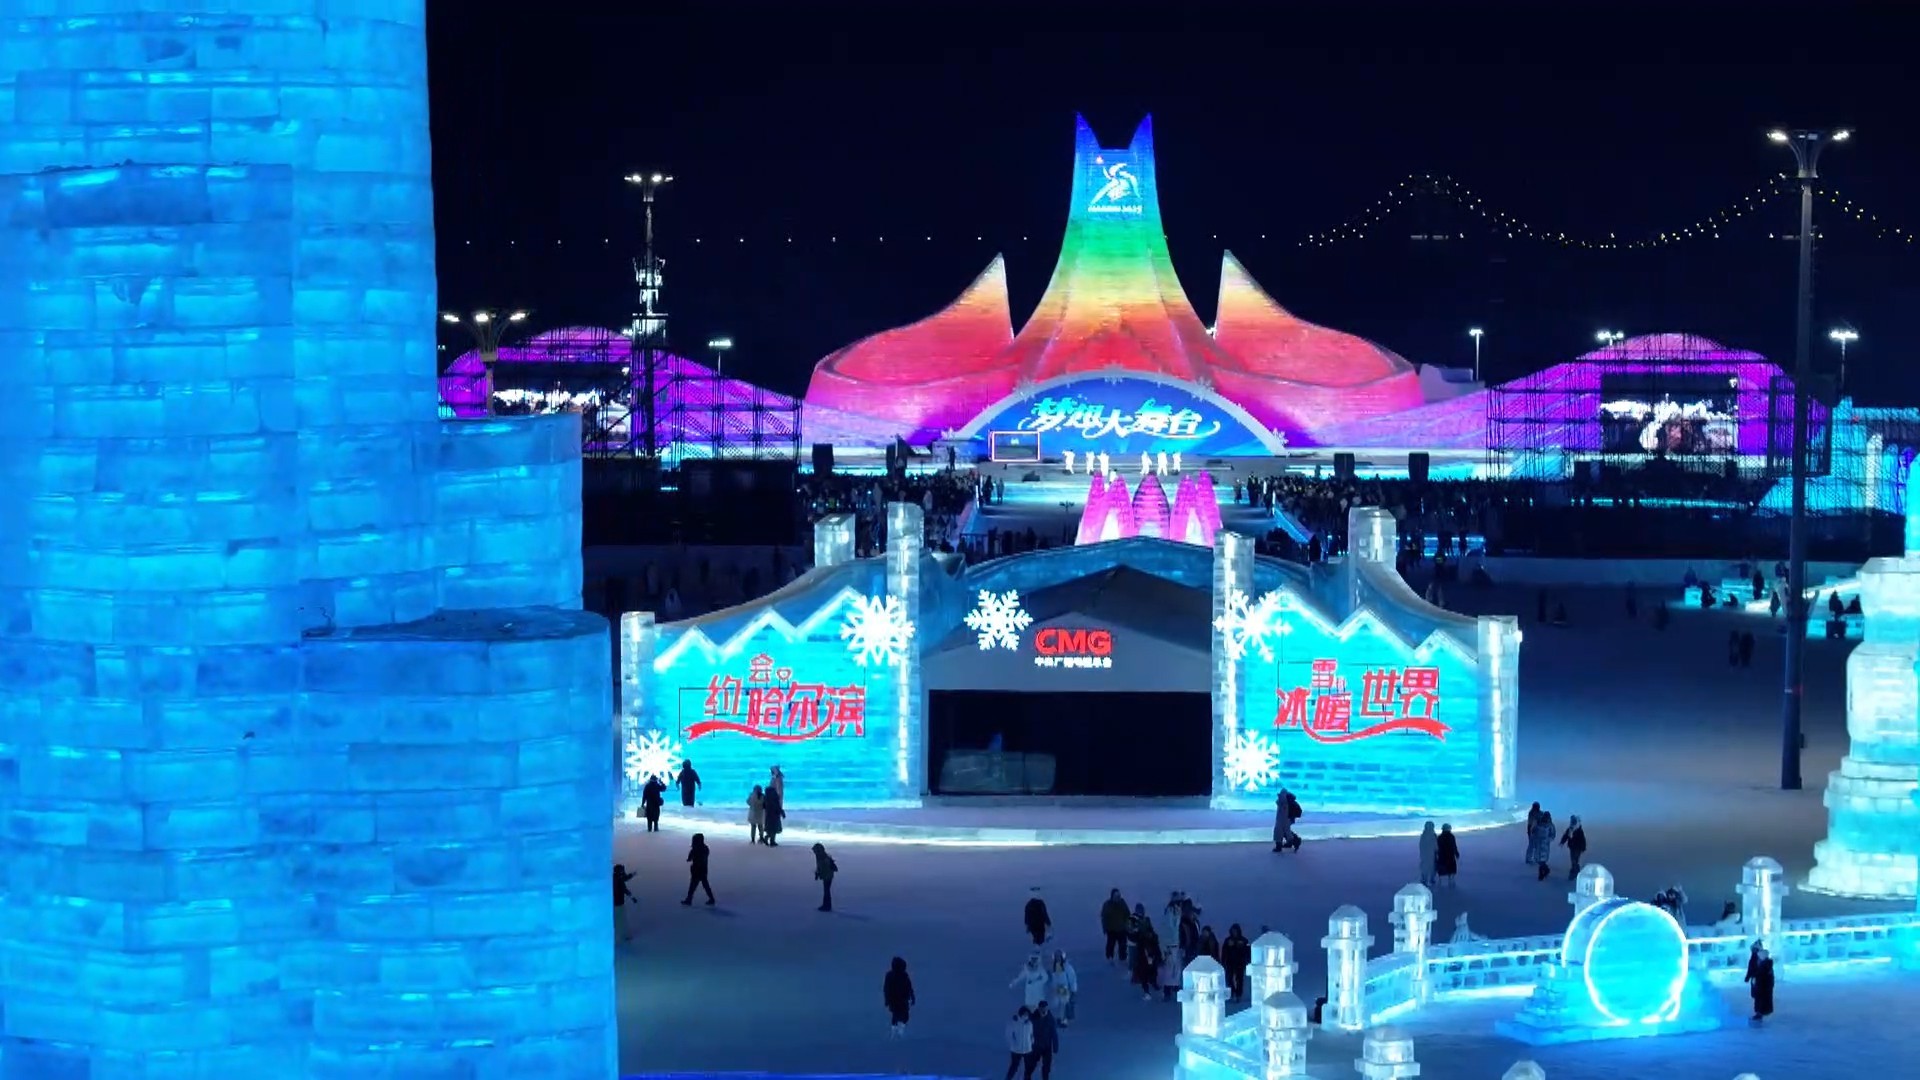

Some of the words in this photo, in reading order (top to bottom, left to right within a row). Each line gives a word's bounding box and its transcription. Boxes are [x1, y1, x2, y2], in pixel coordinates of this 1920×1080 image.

[1020, 397, 1219, 438] 梦想大舞台
[1035, 629, 1112, 654] CMG
